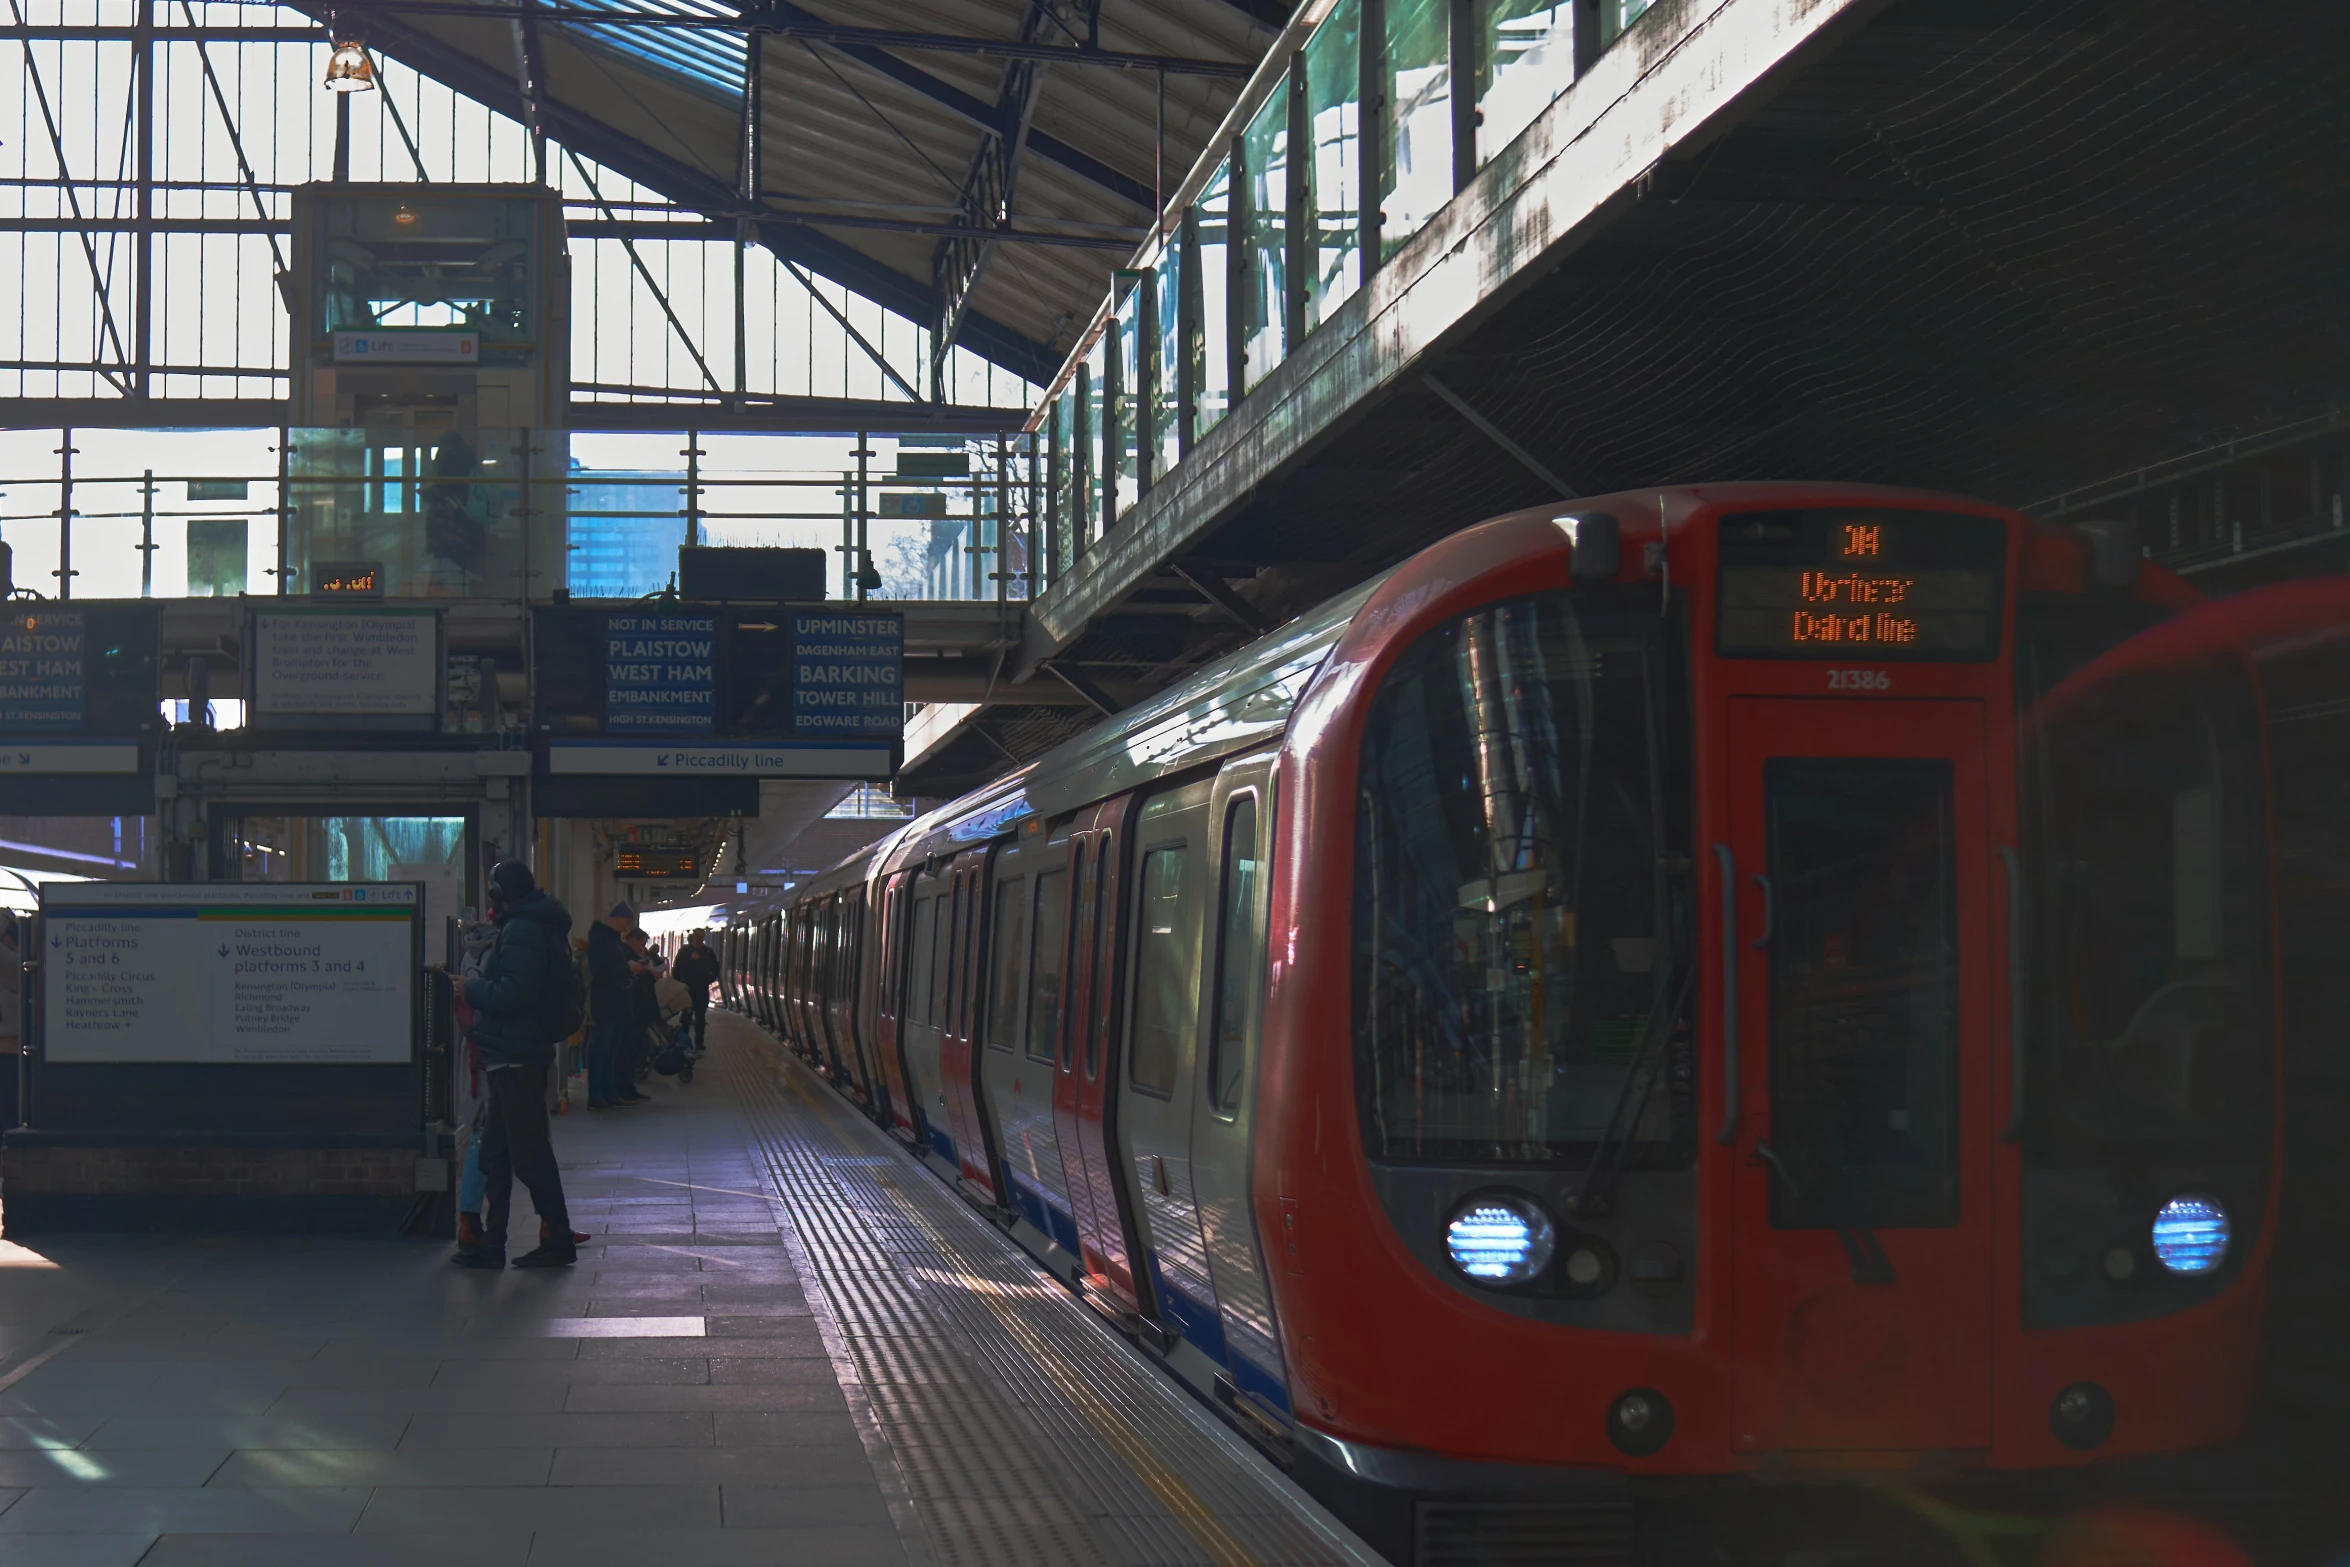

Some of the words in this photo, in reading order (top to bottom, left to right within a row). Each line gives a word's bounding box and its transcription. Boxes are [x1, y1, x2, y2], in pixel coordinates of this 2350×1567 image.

[372, 340, 393, 352] Lift
[273, 620, 291, 629] For
[295, 620, 358, 631] Kensington
[608, 618, 636, 631] NOT
[642, 618, 656, 631] IN
[661, 618, 713, 631] SERVICE
[797, 620, 899, 635] UPMINSTER
[302, 632, 320, 642] the
[325, 632, 347, 642] first
[353, 632, 417, 642] Wimbledon
[273, 646, 298, 655] train
[303, 646, 322, 655] and
[327, 646, 366, 657] change
[371, 646, 381, 655] at
[387, 646, 415, 655] West
[609, 641, 711, 658] PLAISTOW
[797, 645, 866, 656] DAGENHAM
[870, 645, 898, 656] EAST
[37, 660, 81, 676] HAM
[272, 658, 328, 670] Brompton
[333, 658, 349, 667] for
[353, 658, 372, 667] the
[272, 671, 338, 682] Overground
[609, 664, 662, 681] WEST
[668, 665, 711, 681] HAM
[800, 666, 895, 683] BARKING
[1827, 670, 1890, 689] 21386
[609, 690, 712, 704] EMBANKMENT
[797, 691, 858, 705] TOWER
[863, 691, 899, 705] HILL
[609, 715, 633, 724] HIGH
[796, 715, 860, 726] EDGWARE
[863, 715, 900, 726] ROAD
[675, 753, 749, 769] Piccadilly
[756, 753, 783, 767] line
[382, 891, 400, 899] Lift
[66, 923, 117, 933] Piccadilly
[121, 923, 141, 932] line
[235, 929, 275, 938] District
[280, 929, 301, 938] line
[66, 937, 138, 948] Platforms
[236, 945, 320, 956] Westbound
[66, 953, 74, 964] 5
[80, 953, 105, 964] and
[112, 953, 120, 964] 6
[235, 961, 306, 975] platforms
[312, 961, 319, 972] 3
[325, 961, 351, 972] and
[356, 961, 365, 972] 4
[66, 972, 116, 981] Piccadilly
[121, 972, 155, 981] Circus
[102, 984, 133, 993] Cross
[235, 982, 288, 992] Kensington
[290, 982, 335, 992] (Olympia)
[66, 996, 143, 1005] Hammersmith
[235, 993, 282, 1001] Richmond
[66, 1008, 109, 1018] Rayners
[114, 1008, 139, 1017] Lane
[235, 1003, 263, 1012] Ealing
[266, 1003, 311, 1013] Broadway
[235, 1014, 268, 1023] Putney
[271, 1014, 300, 1023] Bridge
[66, 1020, 120, 1029] Heathrow
[236, 1025, 290, 1033] Wimbledon
